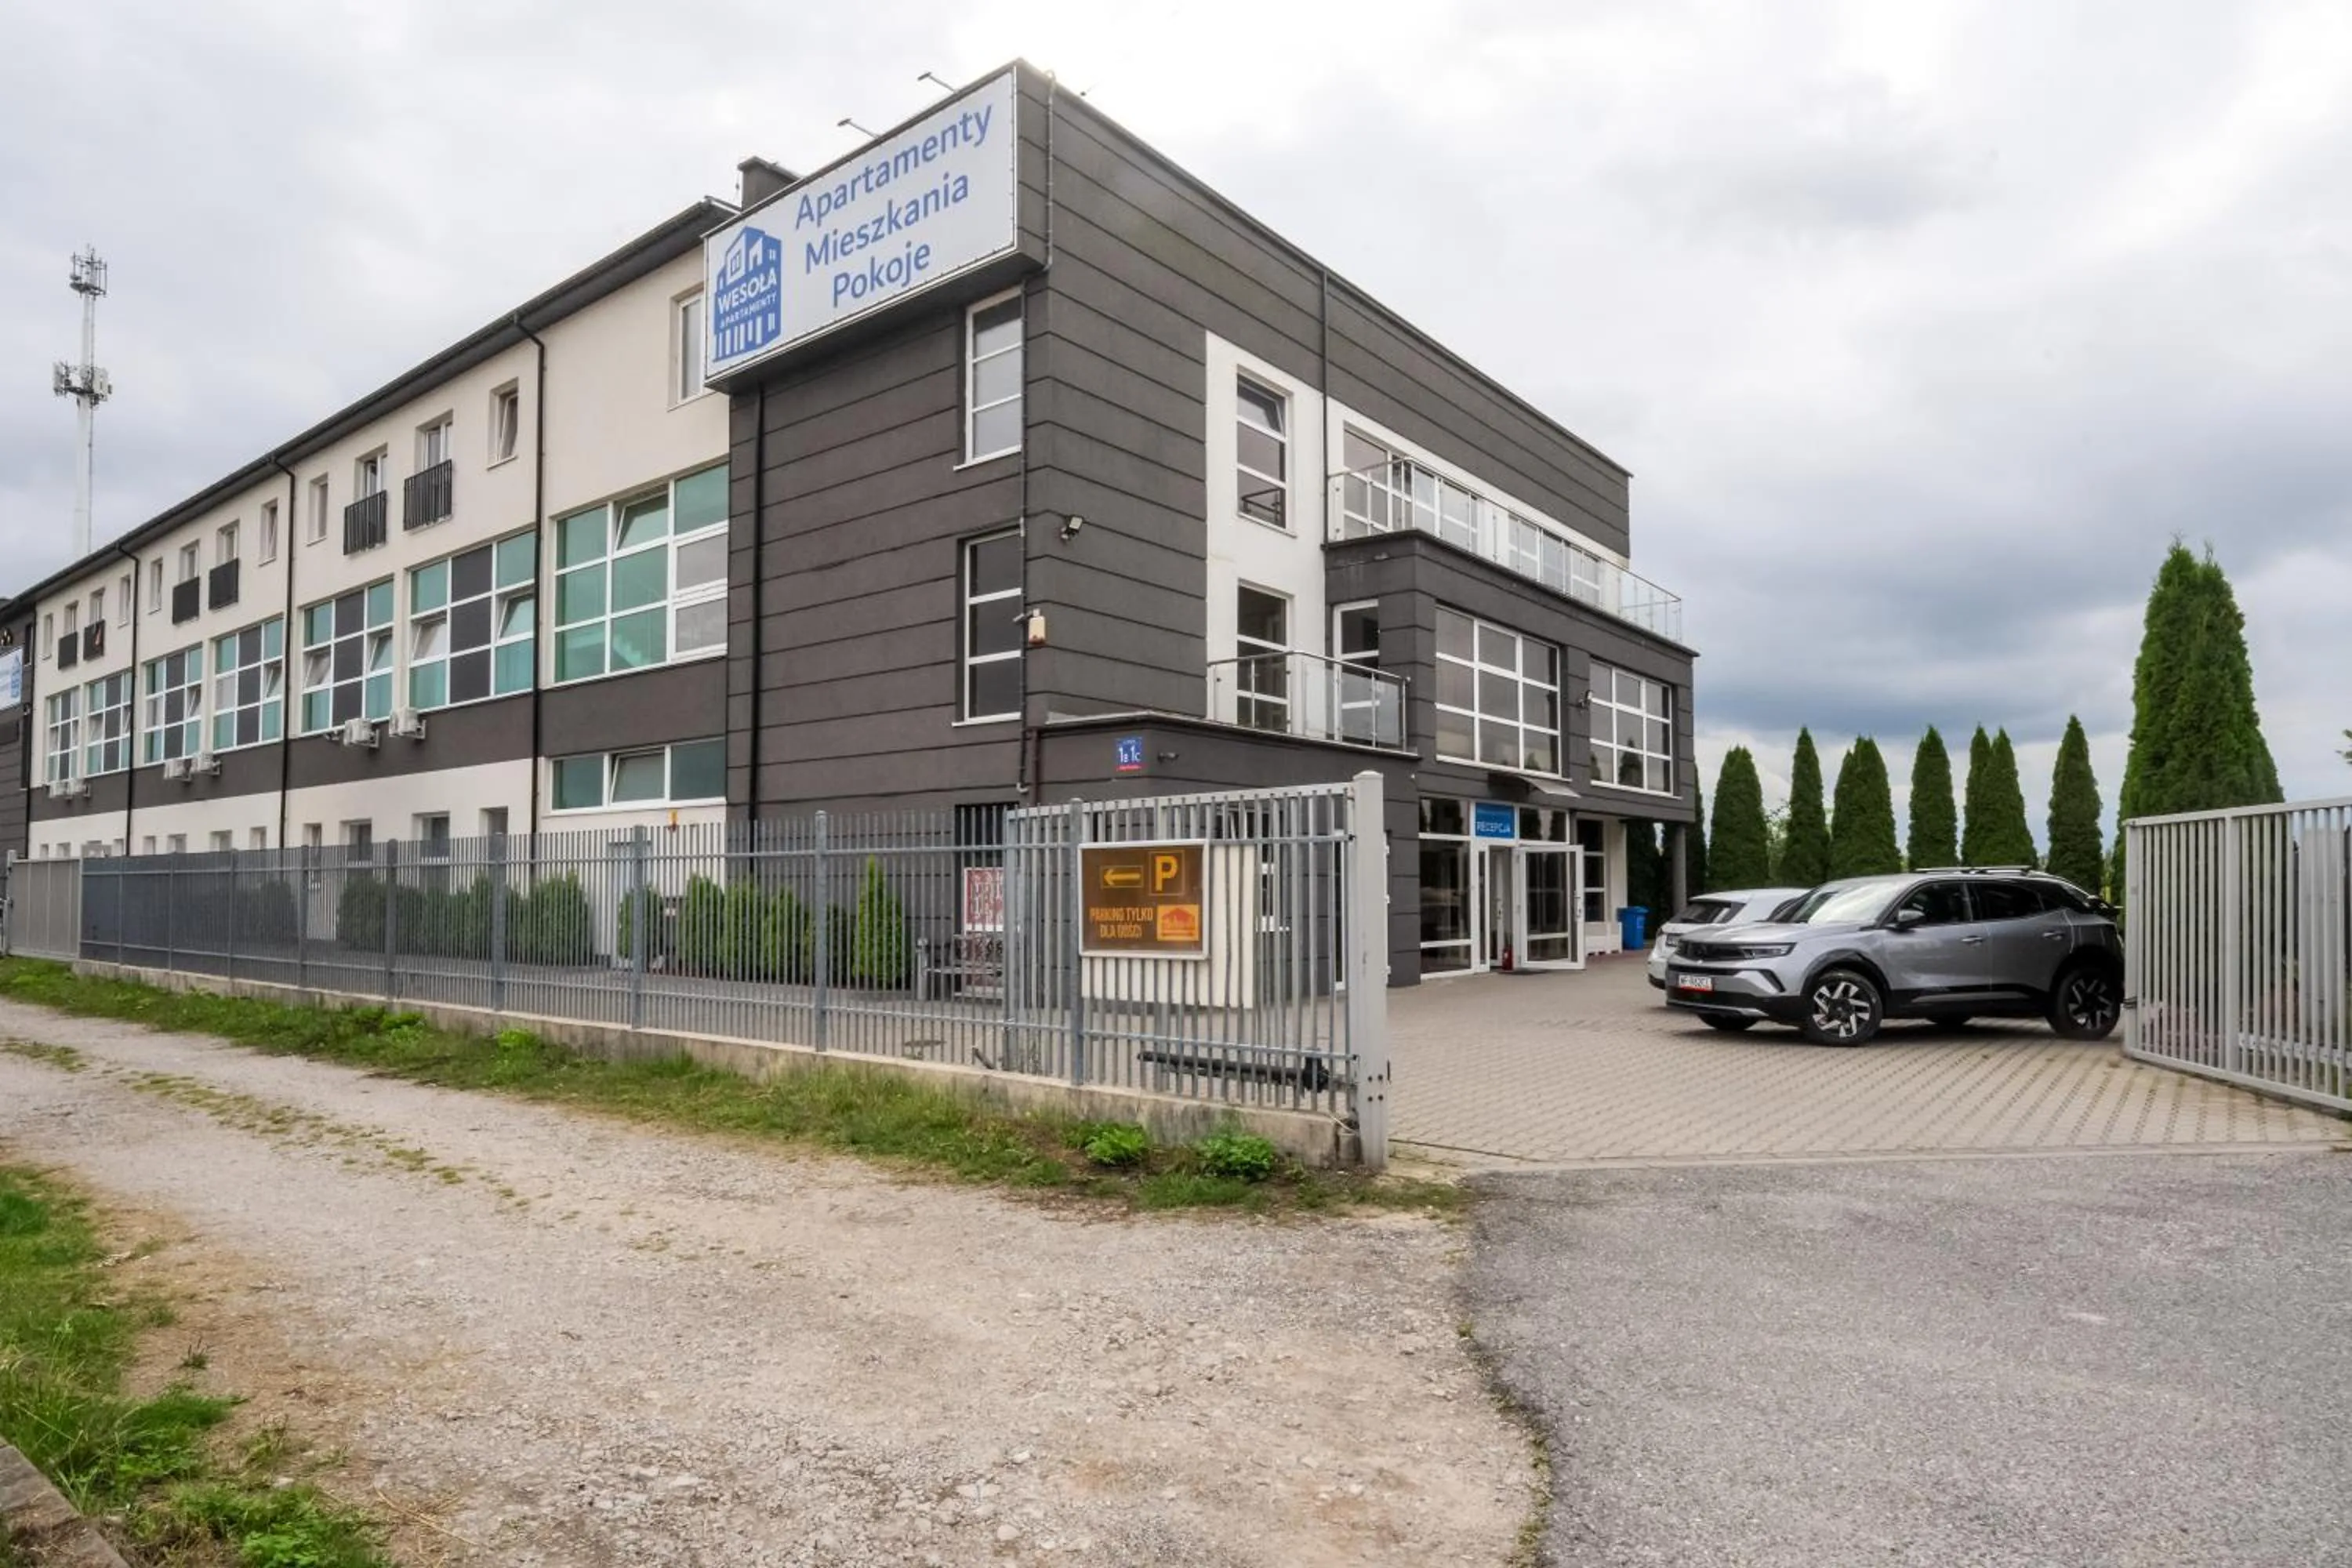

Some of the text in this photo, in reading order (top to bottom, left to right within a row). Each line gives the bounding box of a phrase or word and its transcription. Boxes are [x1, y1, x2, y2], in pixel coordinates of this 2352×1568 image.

[796, 104, 992, 230] Apartamenty
[805, 172, 969, 274] Mieszkania
[717, 267, 777, 314] WESOŁA
[833, 240, 931, 308] Pokoje
[1476, 821, 1511, 833] RECEPCJA
[1154, 855, 1178, 892] P
[1089, 906, 1154, 923] PARKING TYLKO
[1100, 924, 1116, 938] DLA
